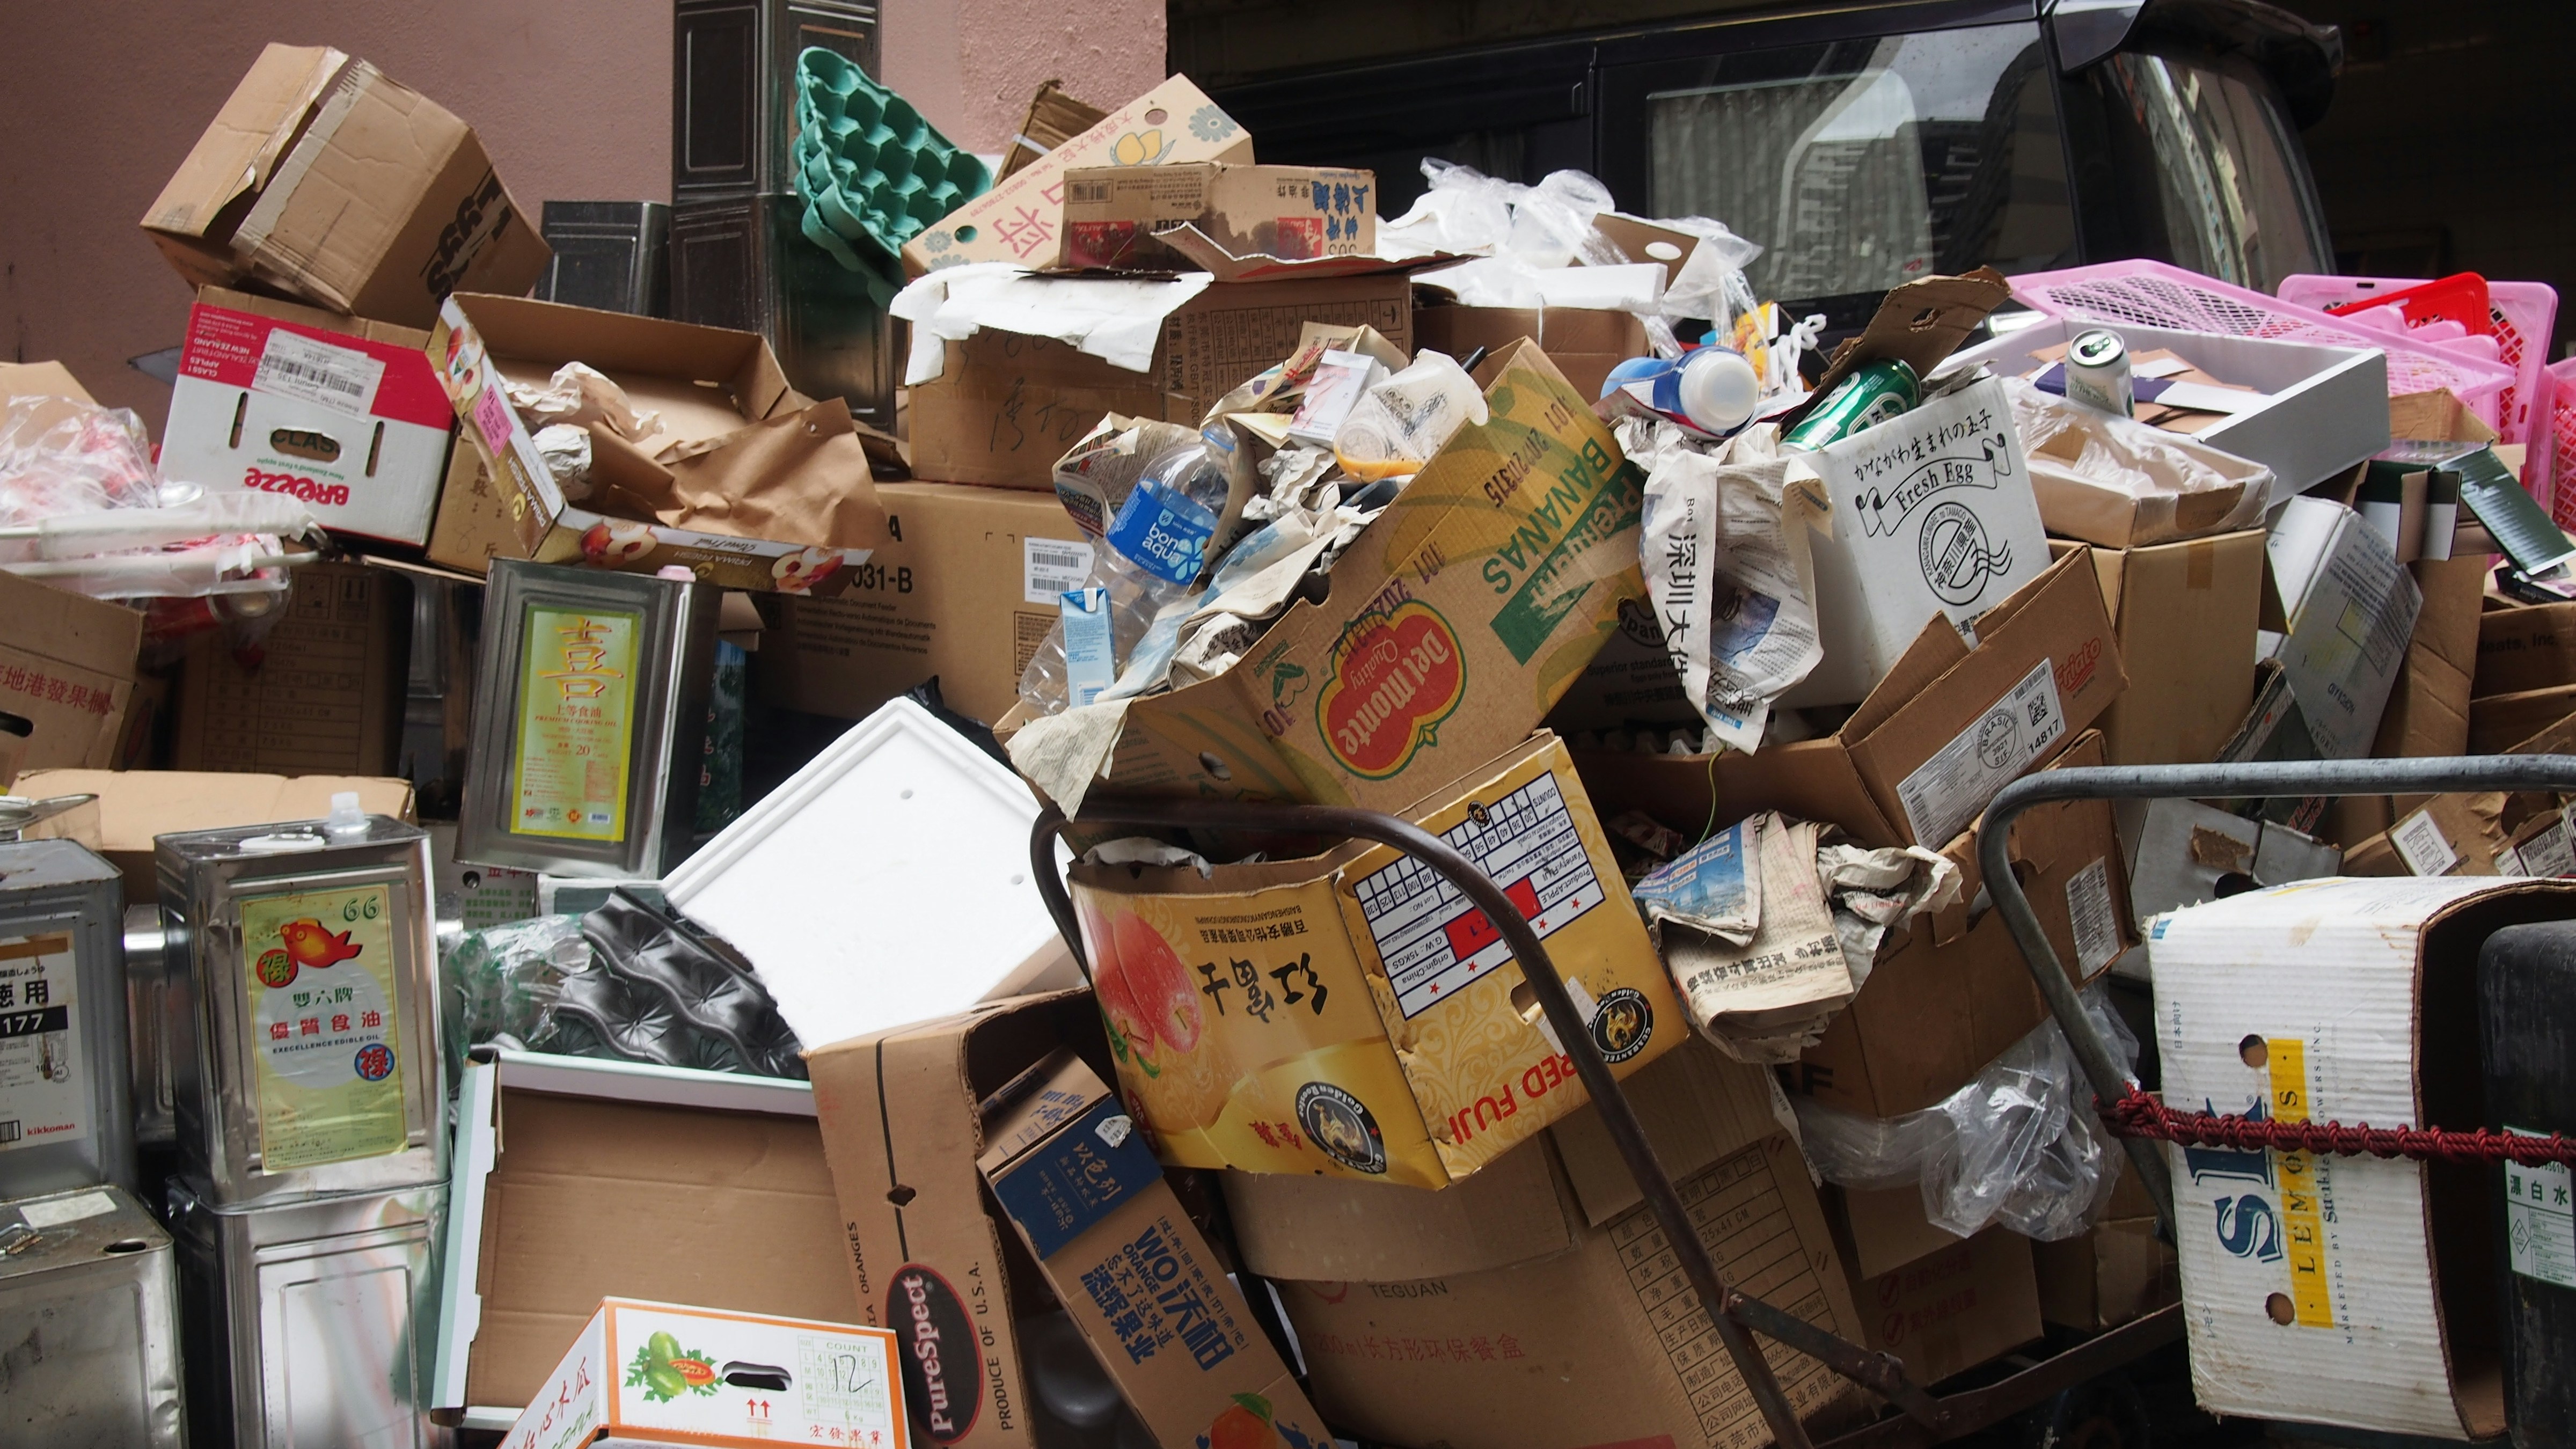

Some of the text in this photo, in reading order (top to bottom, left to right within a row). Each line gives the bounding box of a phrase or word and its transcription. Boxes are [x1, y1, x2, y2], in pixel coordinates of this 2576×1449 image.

[194, 338, 250, 355] NEW ZEALAND
[190, 356, 219, 367] APPLES
[194, 368, 218, 377] CLASS
[296, 378, 318, 391] Count
[337, 400, 359, 413] Breeze
[271, 428, 342, 454] CLAS
[257, 457, 345, 481] New Zealand's first apple
[1896, 462, 1973, 514] Fresh Egg
[1483, 436, 1612, 595] BANANAS
[1945, 506, 1967, 521] TAMAGO
[1148, 521, 1183, 556] bon
[715, 555, 752, 567] PRIMA
[1141, 537, 1182, 566] aqua
[1934, 518, 1977, 590] 神奈川県産
[851, 599, 896, 612] Document Feeder
[905, 619, 936, 630] Documents
[2480, 633, 2558, 654] eats, Inc.
[537, 616, 625, 702] 喜
[1350, 636, 1399, 690] Quality
[2053, 635, 2103, 696] Friato
[1337, 628, 1450, 756] Del Monte
[535, 715, 569, 723] PREMIUM
[569, 718, 603, 726] COOKING
[554, 704, 602, 718] 上等食油
[1982, 716, 2010, 747] BRASIL
[2027, 719, 2060, 754] 14817
[576, 745, 590, 757] 20
[1992, 739, 2009, 757] 3921
[1532, 786, 1557, 809] COUNTS
[1511, 817, 1521, 831] 36
[1524, 811, 1534, 823] 30
[1487, 833, 1497, 846] 48
[1499, 825, 1510, 838] 40
[1474, 840, 1485, 852] 56
[1406, 878, 1421, 892] 100
[1422, 872, 1433, 884] 88
[1541, 867, 1591, 904] Product:APPLE
[1379, 894, 1393, 909] 125
[1393, 886, 1407, 900] 113
[1424, 894, 1435, 905] Lot
[342, 894, 380, 923] 66
[1365, 902, 1379, 917] 138
[1392, 949, 1421, 970] 15KGS
[1401, 953, 1450, 985] origin:China
[293, 987, 355, 1007] 雙六牌
[3, 1012, 43, 1034] 177
[269, 1011, 382, 1041] 優質食油
[2171, 999, 2183, 1050] 日本向け
[272, 1034, 380, 1055] EXECELLENCE EDIBLE OIL
[1298, 1084, 1364, 1121] Golden Rooster
[1447, 1049, 1577, 1146] RED FUJI
[26, 1121, 77, 1137] kikkoman
[2278, 1090, 2318, 1275] LEMOS
[2313, 1021, 2355, 1344] MARKETED BY INC.
[1620, 1213, 1656, 1240] 颜色
[1735, 1208, 1750, 1224] CM
[846, 1221, 870, 1294] ORANGES
[1134, 1225, 1180, 1282] WO
[1630, 1233, 1664, 1262] 数量
[1122, 1243, 1161, 1294] ORANGE
[1639, 1254, 1674, 1281] 体积
[1368, 1279, 1450, 1299] TEGUAN
[1649, 1274, 1685, 1301] 净重
[1106, 1252, 1176, 1349] 忘不了这味道
[1660, 1294, 1695, 1322] 毛重
[1156, 1277, 1235, 1372] 沃柑
[1664, 1310, 1712, 1345] 生产日期
[817, 1353, 822, 1363] 4
[826, 1342, 868, 1353] COUNT
[901, 1272, 953, 1436] PureSpect
[968, 1260, 1015, 1432] PRODUCE OF U.S.A.
[1675, 1331, 1723, 1366] 保质期
[816, 1367, 824, 1377] 10
[833, 1354, 875, 1394] 12
[861, 1358, 866, 1367] 8
[872, 1359, 877, 1368] 9
[1685, 1353, 1733, 1387] 制造厂址
[838, 1370, 846, 1380] 12
[1697, 1374, 1745, 1408] 公司电话
[1705, 1395, 1757, 1434] 公司网址
